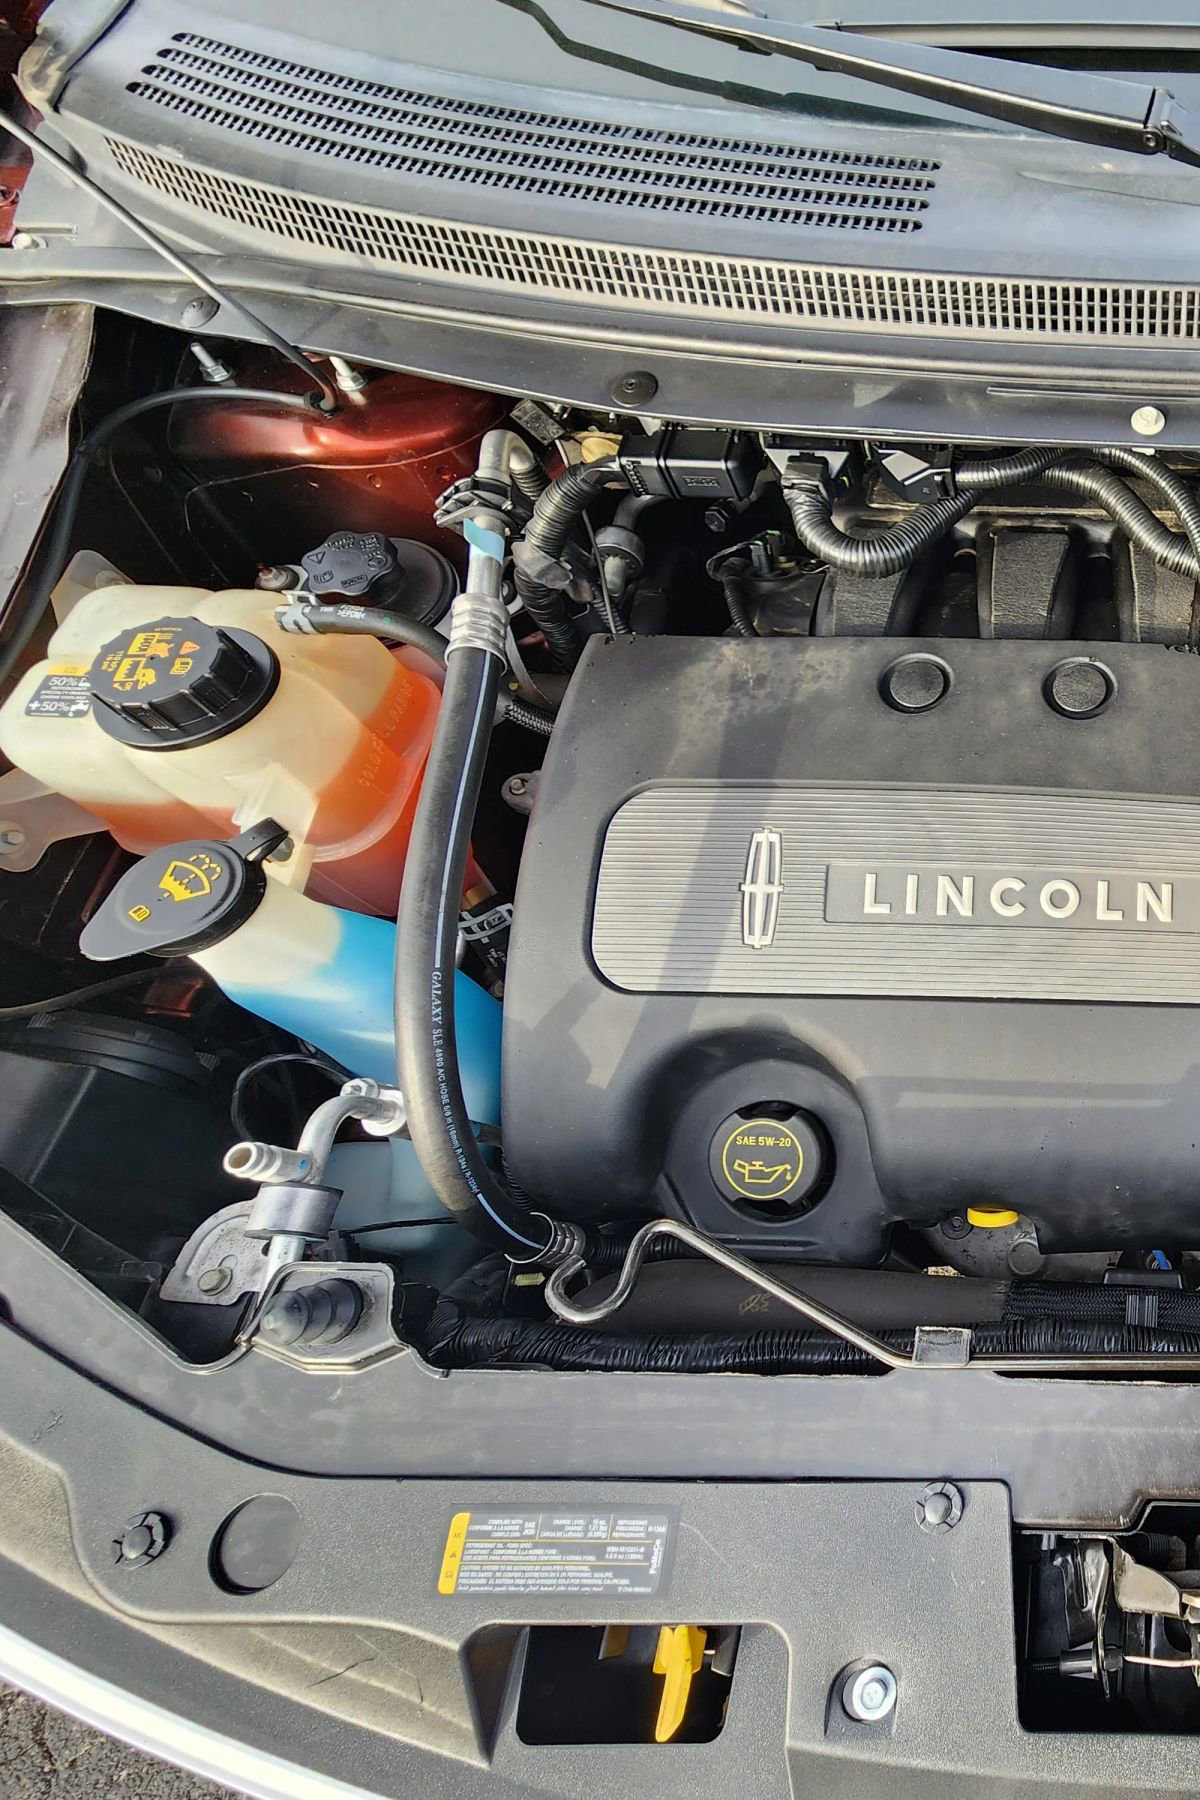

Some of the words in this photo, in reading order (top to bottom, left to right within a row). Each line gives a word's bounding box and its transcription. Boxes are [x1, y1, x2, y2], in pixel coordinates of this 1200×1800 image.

[48, 676, 78, 687] 50%
[862, 872, 1175, 924] LINCOLN
[431, 971, 442, 1024] GALAXY
[432, 1028, 443, 1047] SLE
[437, 1067, 447, 1083] A/C
[736, 1136, 756, 1146] SAE
[758, 1136, 792, 1148] 5W-20
[649, 1538, 661, 1575] FoMoCo
